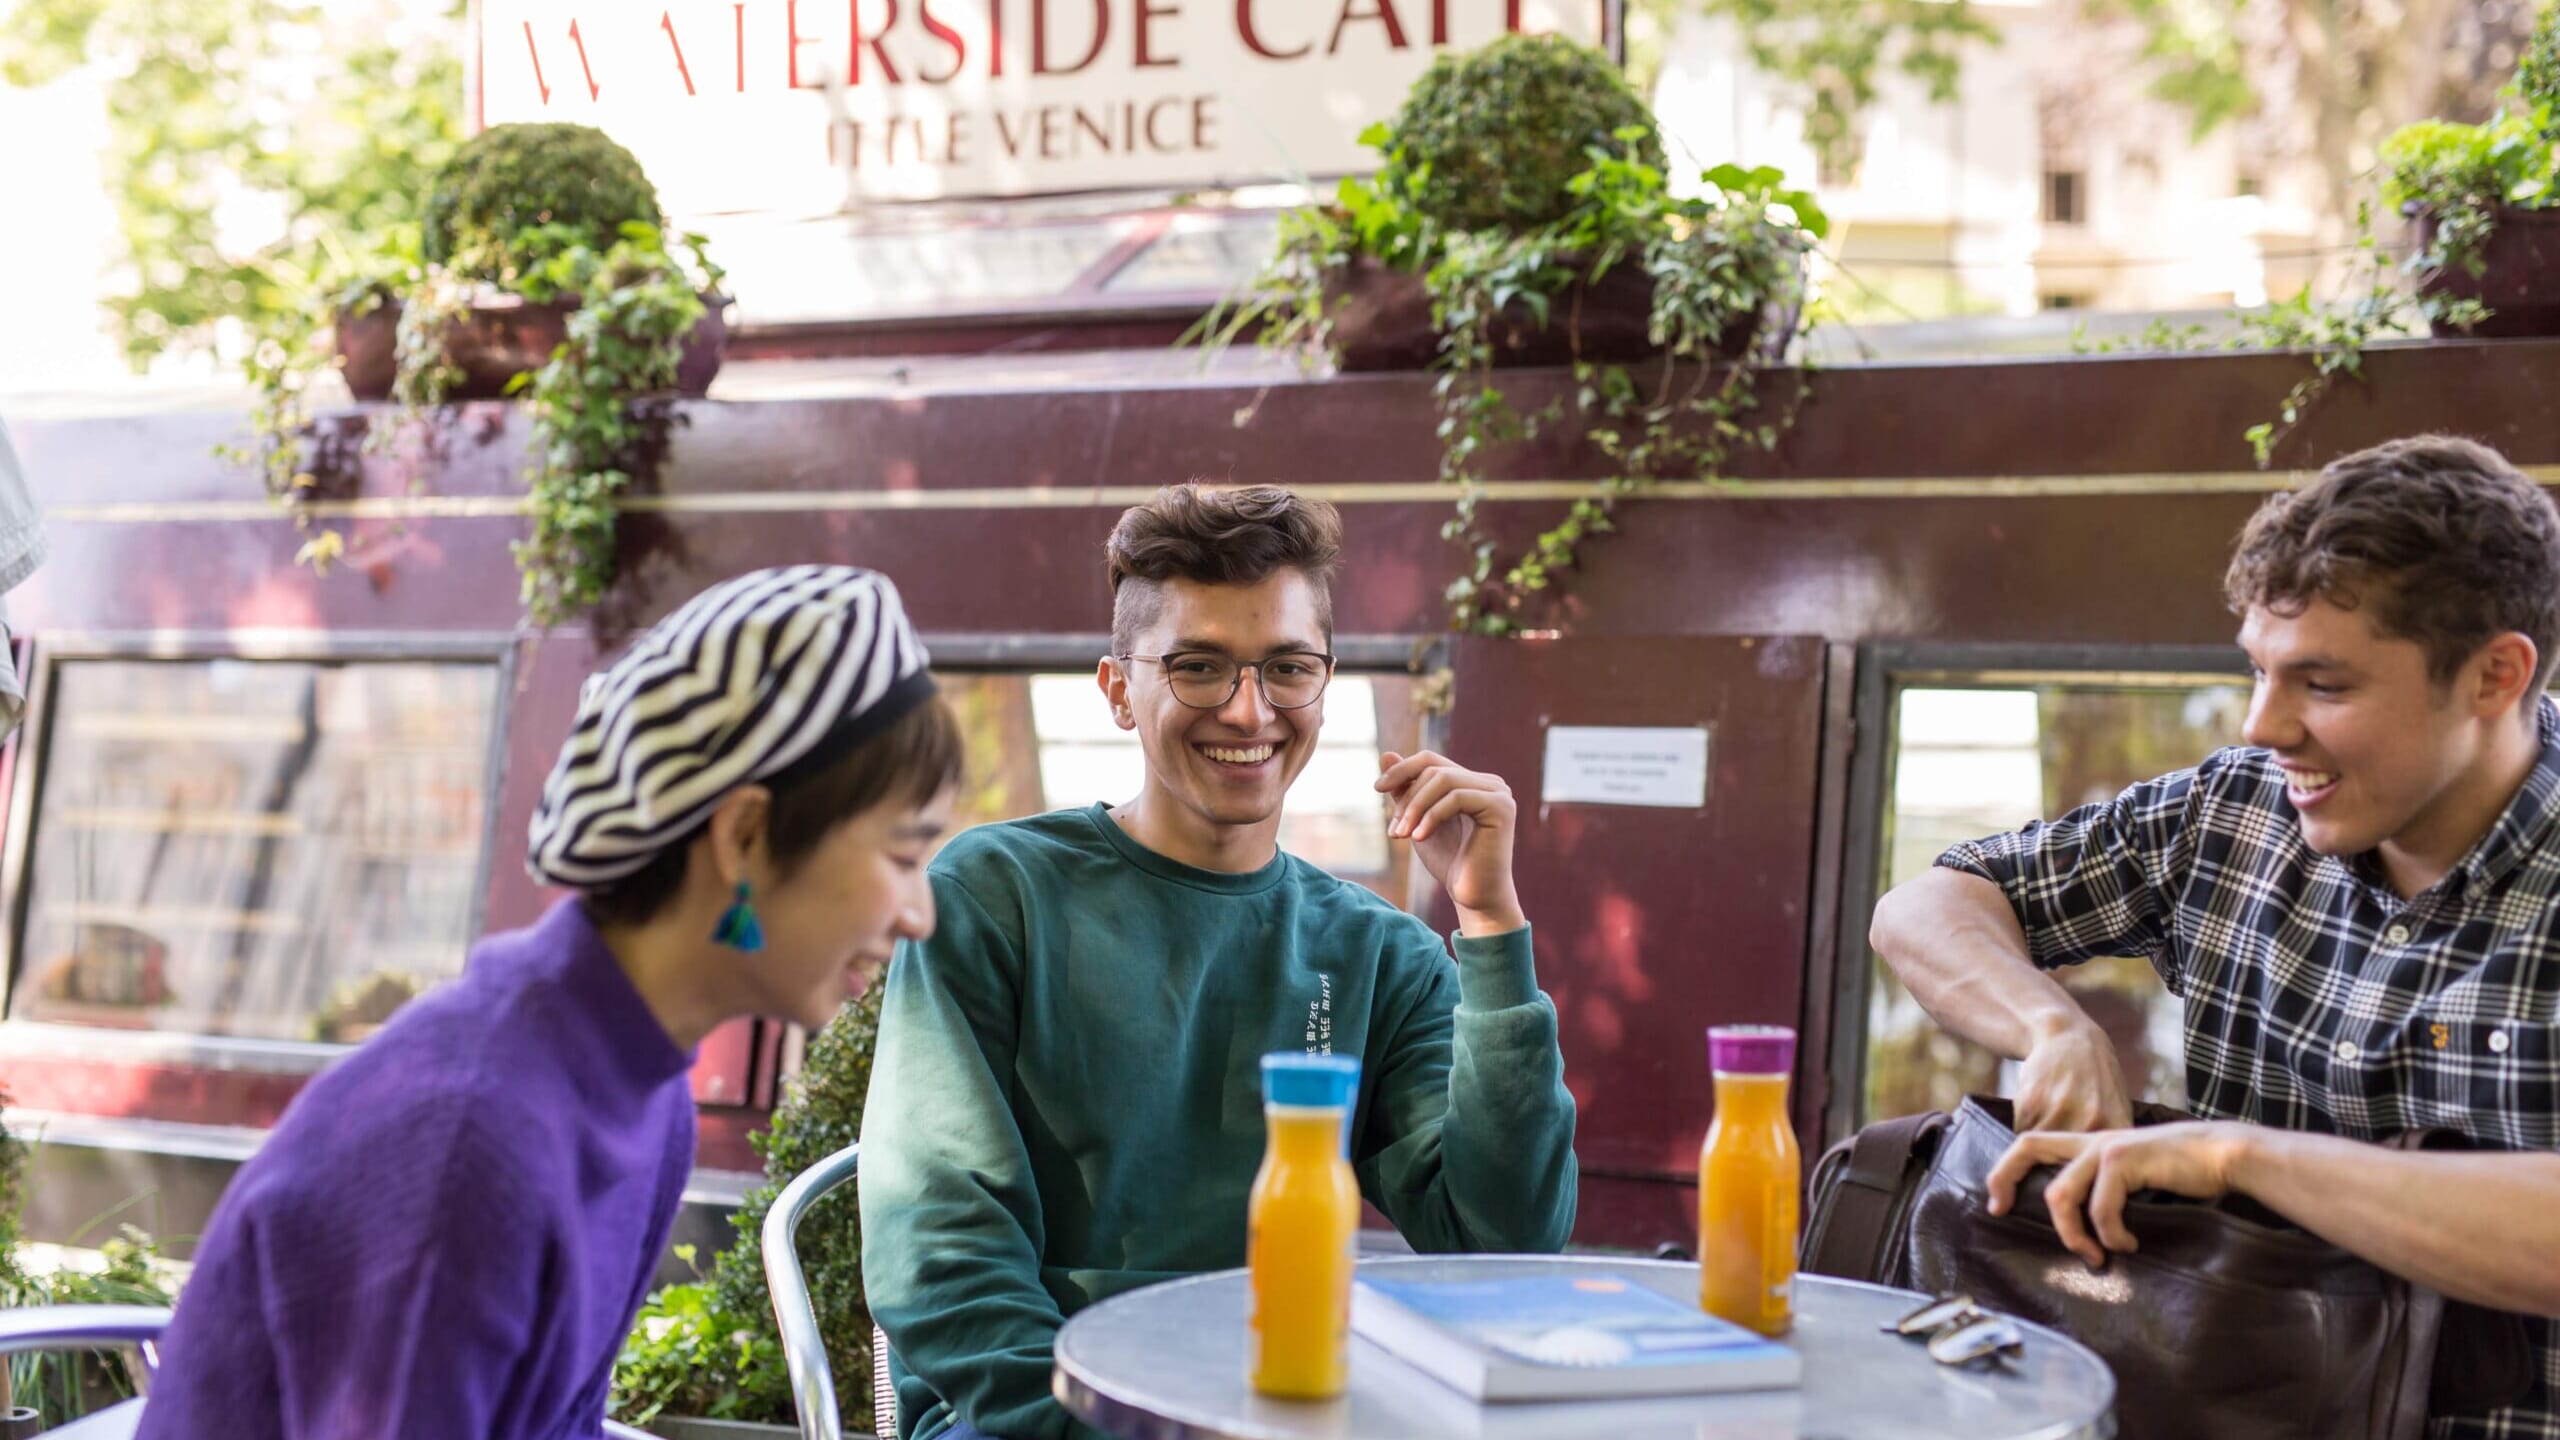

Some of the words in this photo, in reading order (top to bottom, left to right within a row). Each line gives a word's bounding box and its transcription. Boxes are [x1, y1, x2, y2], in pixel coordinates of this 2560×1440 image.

[1233, 0, 1522, 59] CA
[826, 108, 972, 169] ITTLE
[994, 94, 1219, 161] VENICE
